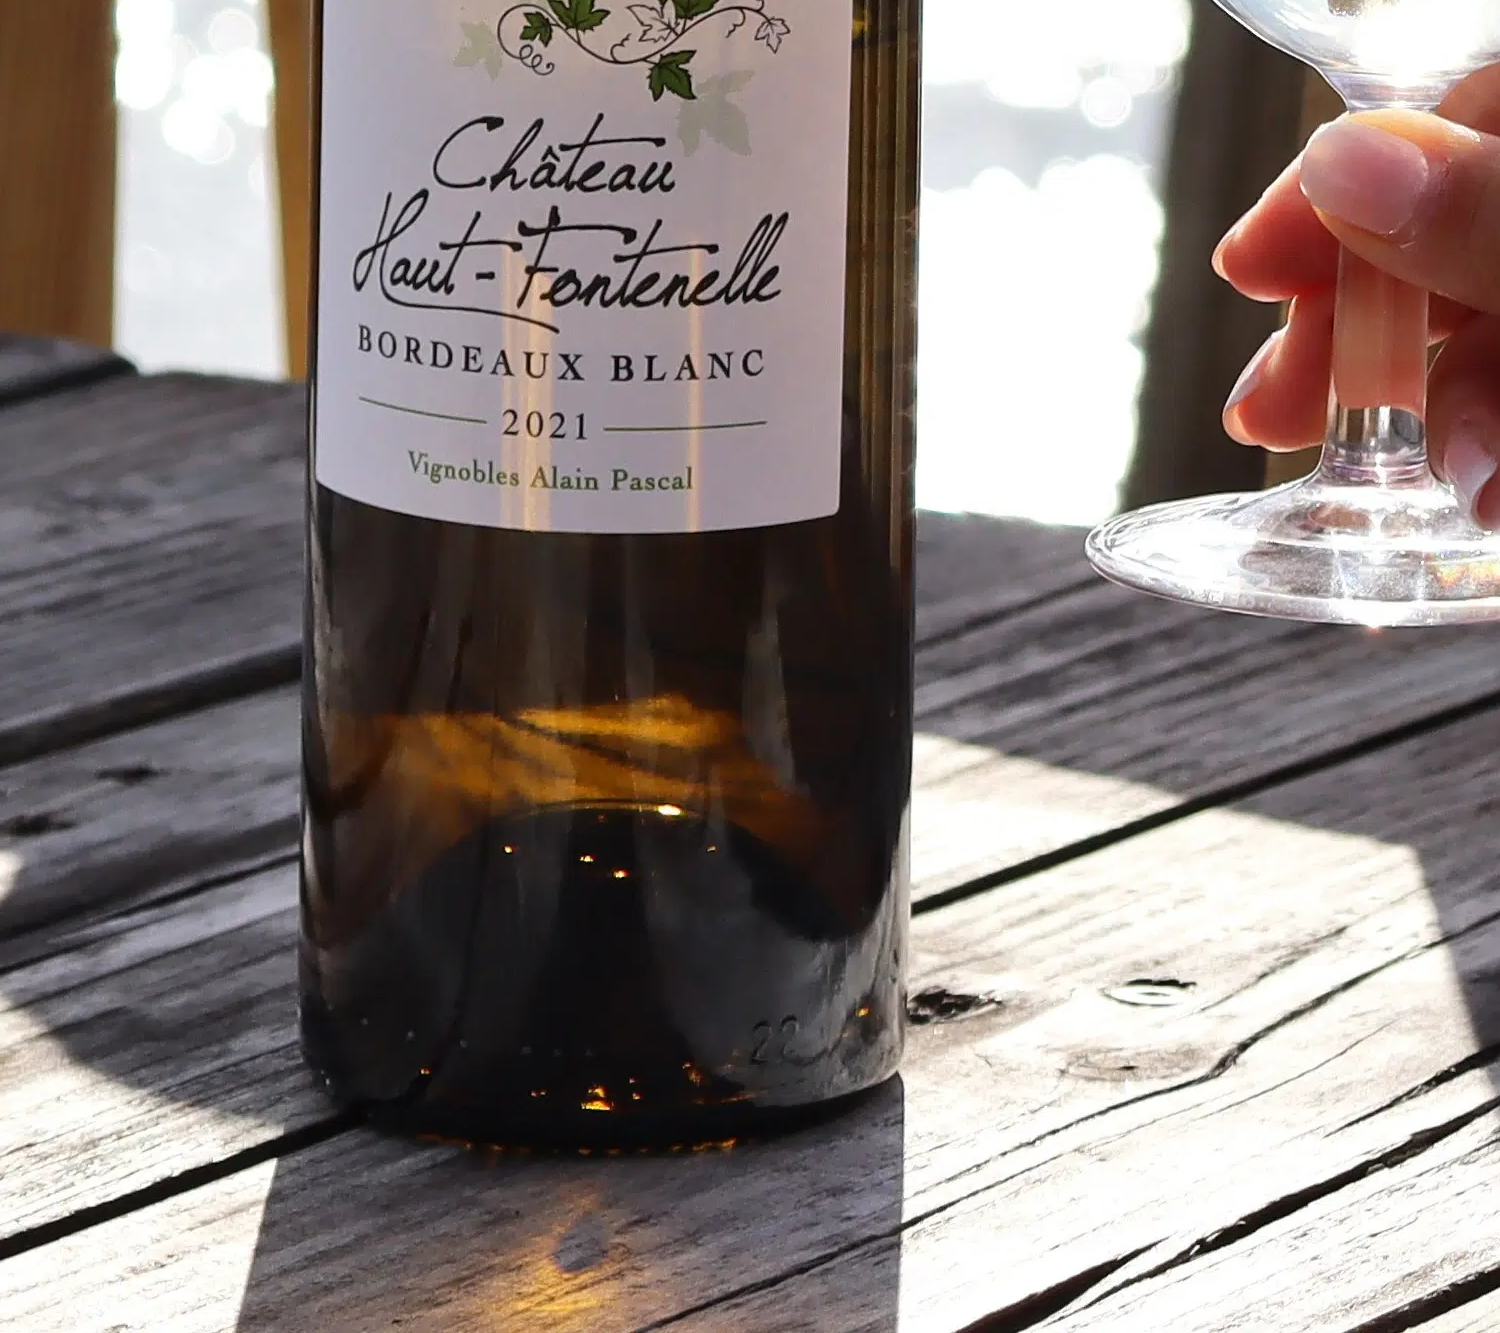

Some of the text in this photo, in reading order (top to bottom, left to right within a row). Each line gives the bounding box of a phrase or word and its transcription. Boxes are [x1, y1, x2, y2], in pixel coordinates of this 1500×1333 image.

[432, 112, 676, 195] Château
[357, 323, 765, 384] BORDEAUX BLANC
[501, 408, 589, 441] 2021
[407, 450, 693, 493] Vignobles Alain Pascal
